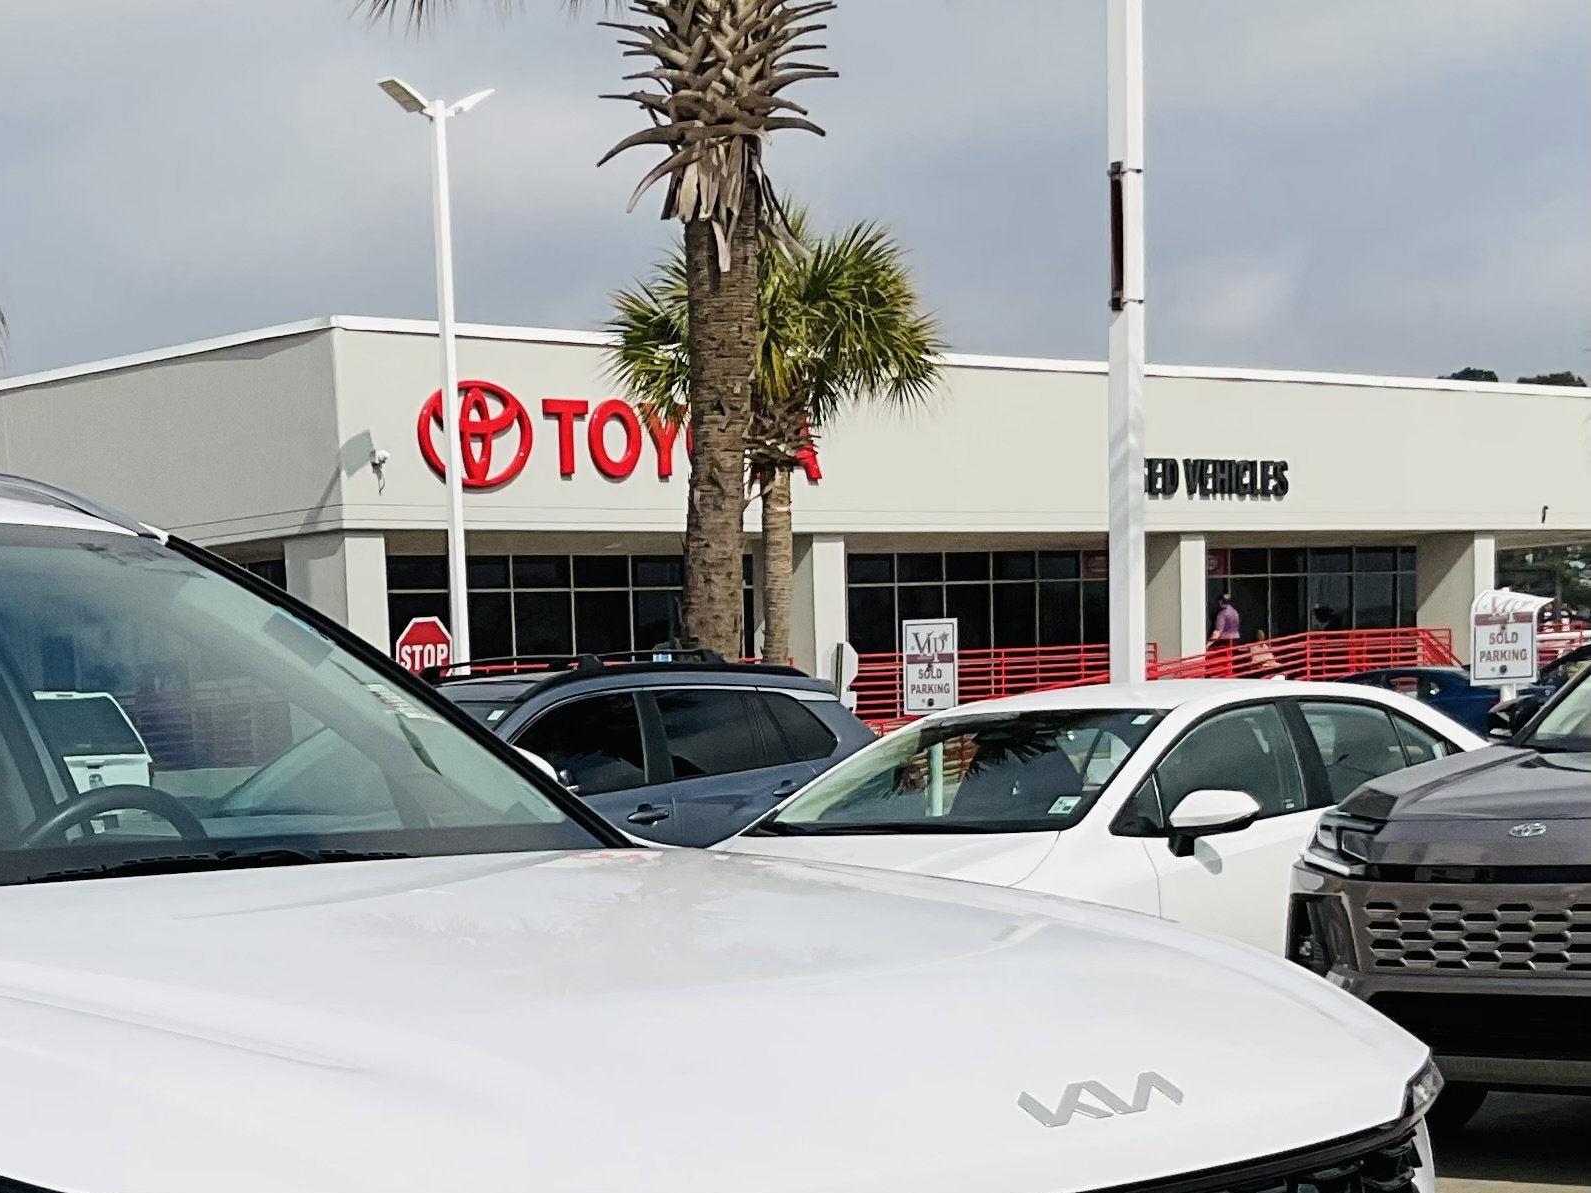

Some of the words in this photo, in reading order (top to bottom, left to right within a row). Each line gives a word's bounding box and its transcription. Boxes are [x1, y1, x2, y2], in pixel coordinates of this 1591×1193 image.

[542, 398, 822, 480] TOY
[1144, 458, 1179, 496] ED
[1182, 458, 1289, 497] VEHICLES
[1489, 631, 1519, 646] SOLD
[401, 643, 448, 671] STOP
[1479, 648, 1528, 663] PARKING
[918, 668, 942, 680] SOLD
[910, 682, 951, 695] PARKING
[1017, 1071, 1184, 1128] KIA
